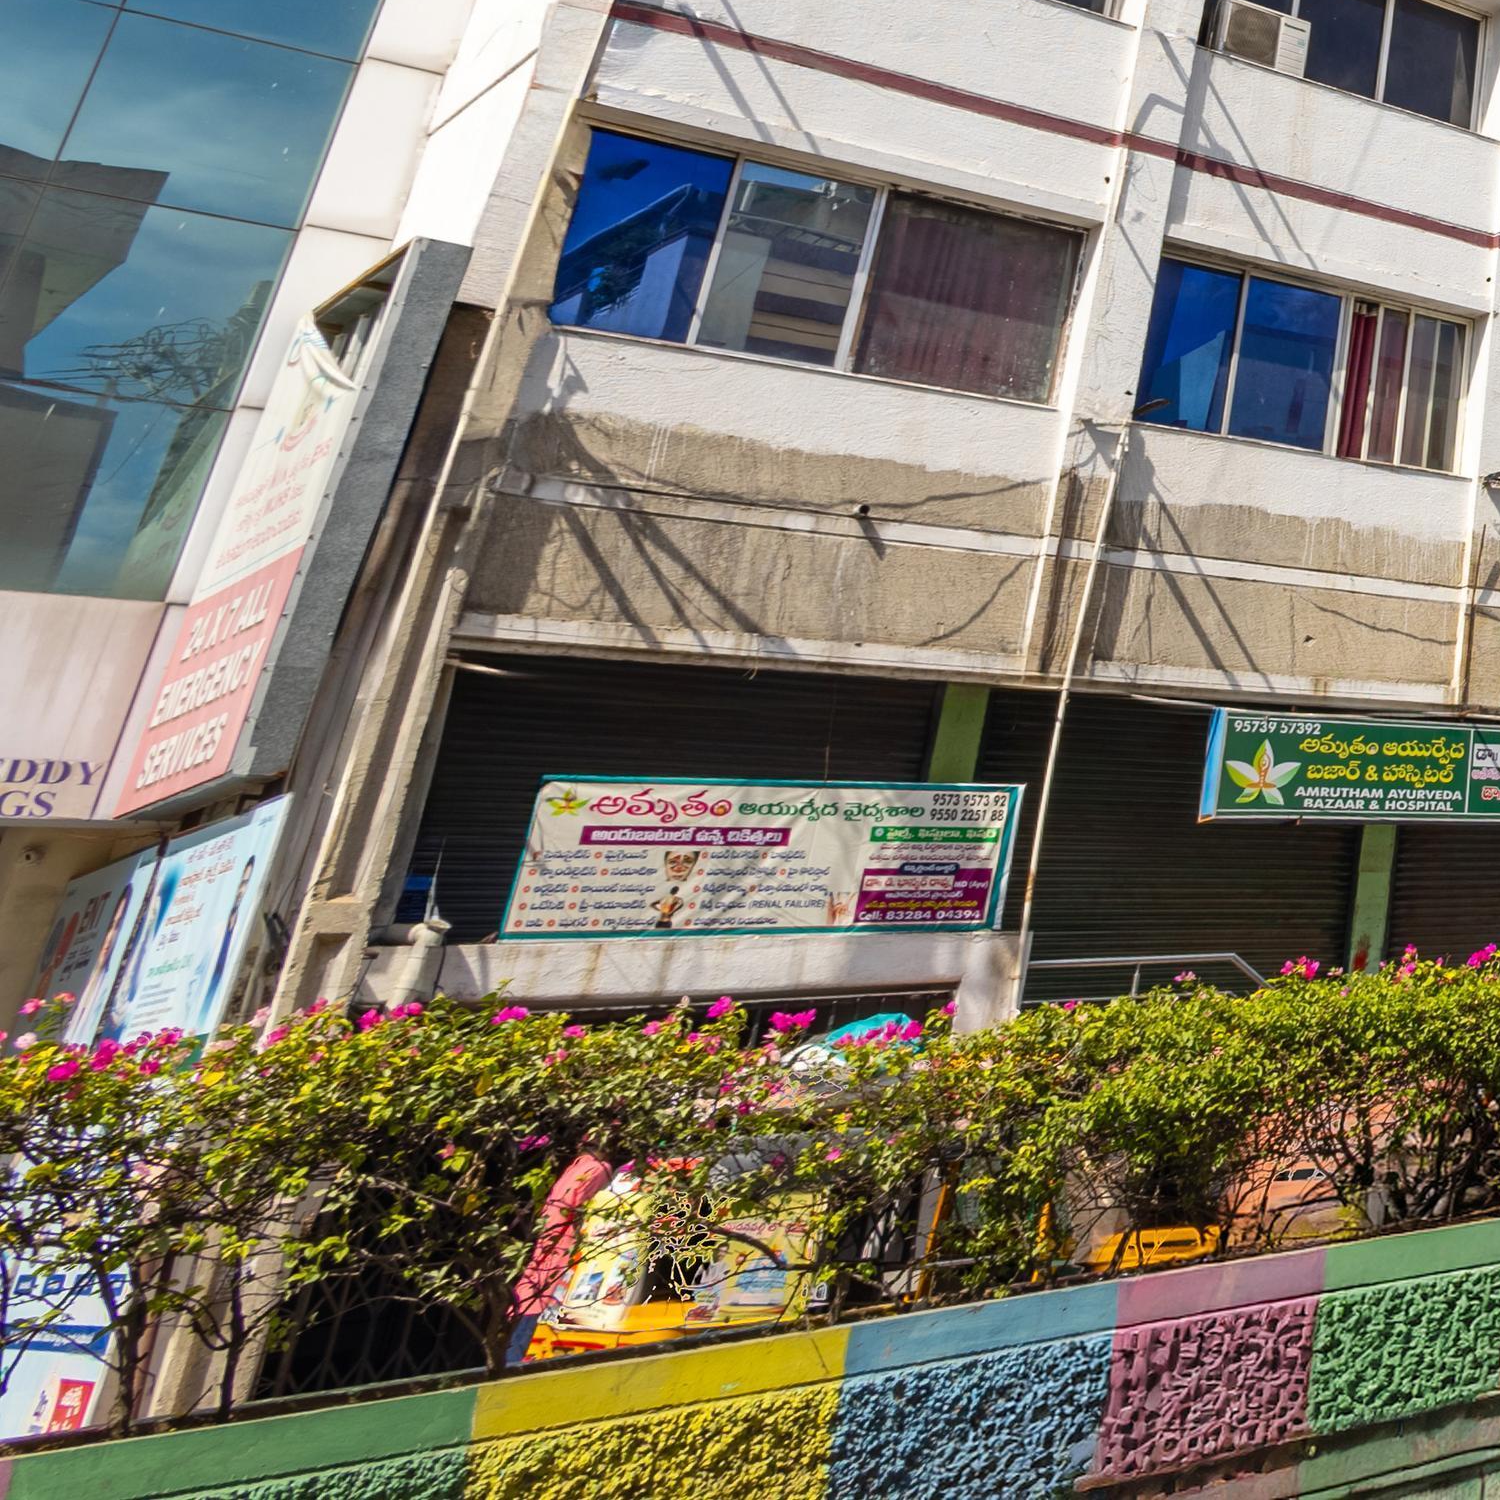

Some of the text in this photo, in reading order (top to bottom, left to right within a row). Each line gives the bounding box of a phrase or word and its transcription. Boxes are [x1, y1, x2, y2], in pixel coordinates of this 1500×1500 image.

[181, 612, 204, 663] 24
[233, 580, 274, 637] ALL
[148, 638, 266, 730] EMERGENCY
[1233, 719, 1277, 733] 95739
[135, 713, 229, 791] SERVICES
[1298, 734, 1465, 765] అమృతం ఆయుర్వేద
[0, 758, 103, 786] DDY
[1306, 760, 1456, 789] బజార్ & హాస్పిటల్
[589, 788, 926, 824] అమృతం ఆయుర్వేద వైద్యశాల
[932, 793, 1006, 807] 9573 9573 92
[1294, 786, 1462, 801] AMRUTHAM AYURVEDA
[1303, 799, 1454, 812] BAZAAR & HOSPITAL
[930, 808, 1004, 821] 9550 2251 88
[858, 910, 981, 920] Cell: 83284 04394
